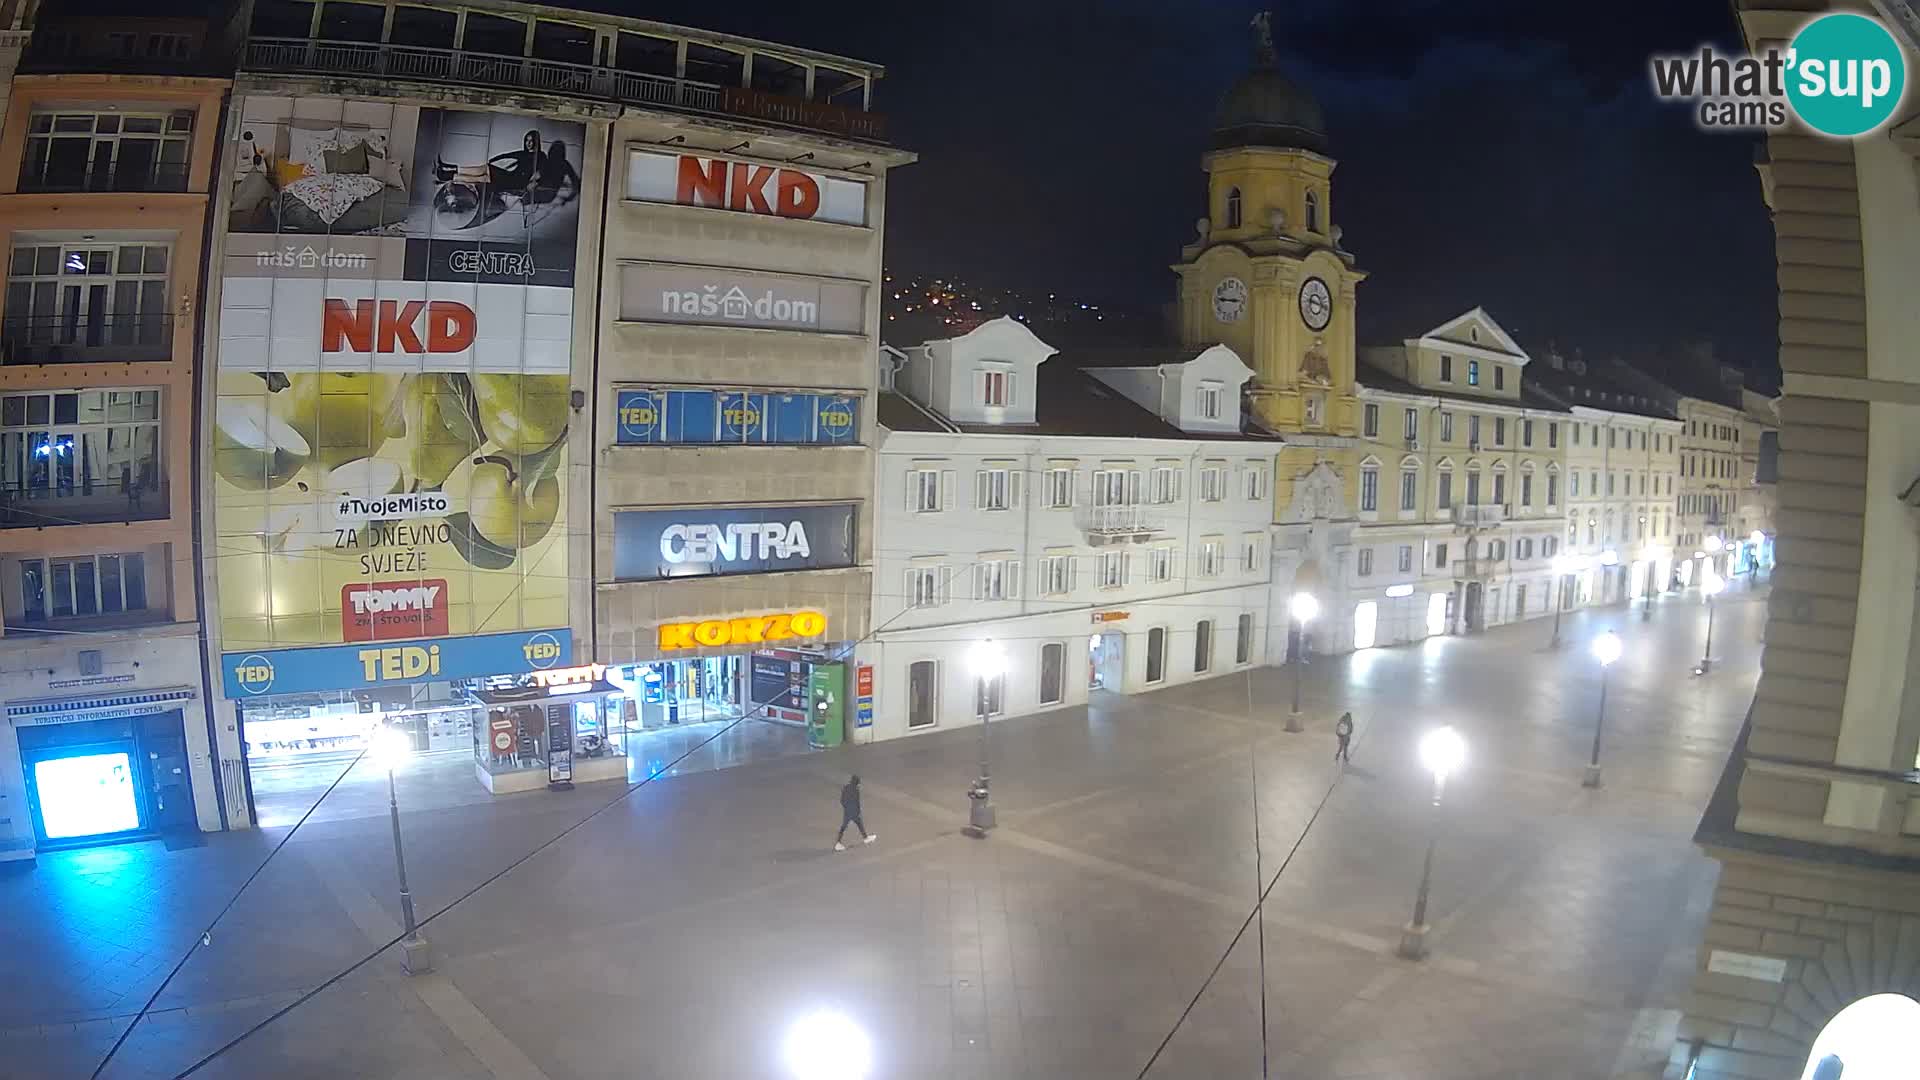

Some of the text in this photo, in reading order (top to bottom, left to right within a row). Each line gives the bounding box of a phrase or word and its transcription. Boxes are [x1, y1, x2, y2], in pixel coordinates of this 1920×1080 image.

[676, 154, 820, 219] NKD
[256, 246, 368, 270] naš dom
[449, 250, 535, 276] CENTRA
[662, 284, 817, 323] naš dom
[322, 297, 477, 354] NKD
[619, 407, 658, 425] TEDi
[723, 409, 761, 426] TEDi
[820, 411, 853, 427] TEDi
[339, 496, 447, 516] #TvojeMisto
[335, 522, 451, 549] ZA DNEVNO
[660, 520, 811, 564] CENTRA
[360, 547, 427, 575] SVJEŽE
[349, 585, 441, 615] TOMMY
[658, 611, 827, 651] KORZO
[358, 644, 441, 682] TEDi
[523, 641, 561, 661] TEDi
[235, 664, 275, 684] TEDi
[533, 663, 607, 687] TOMMY
